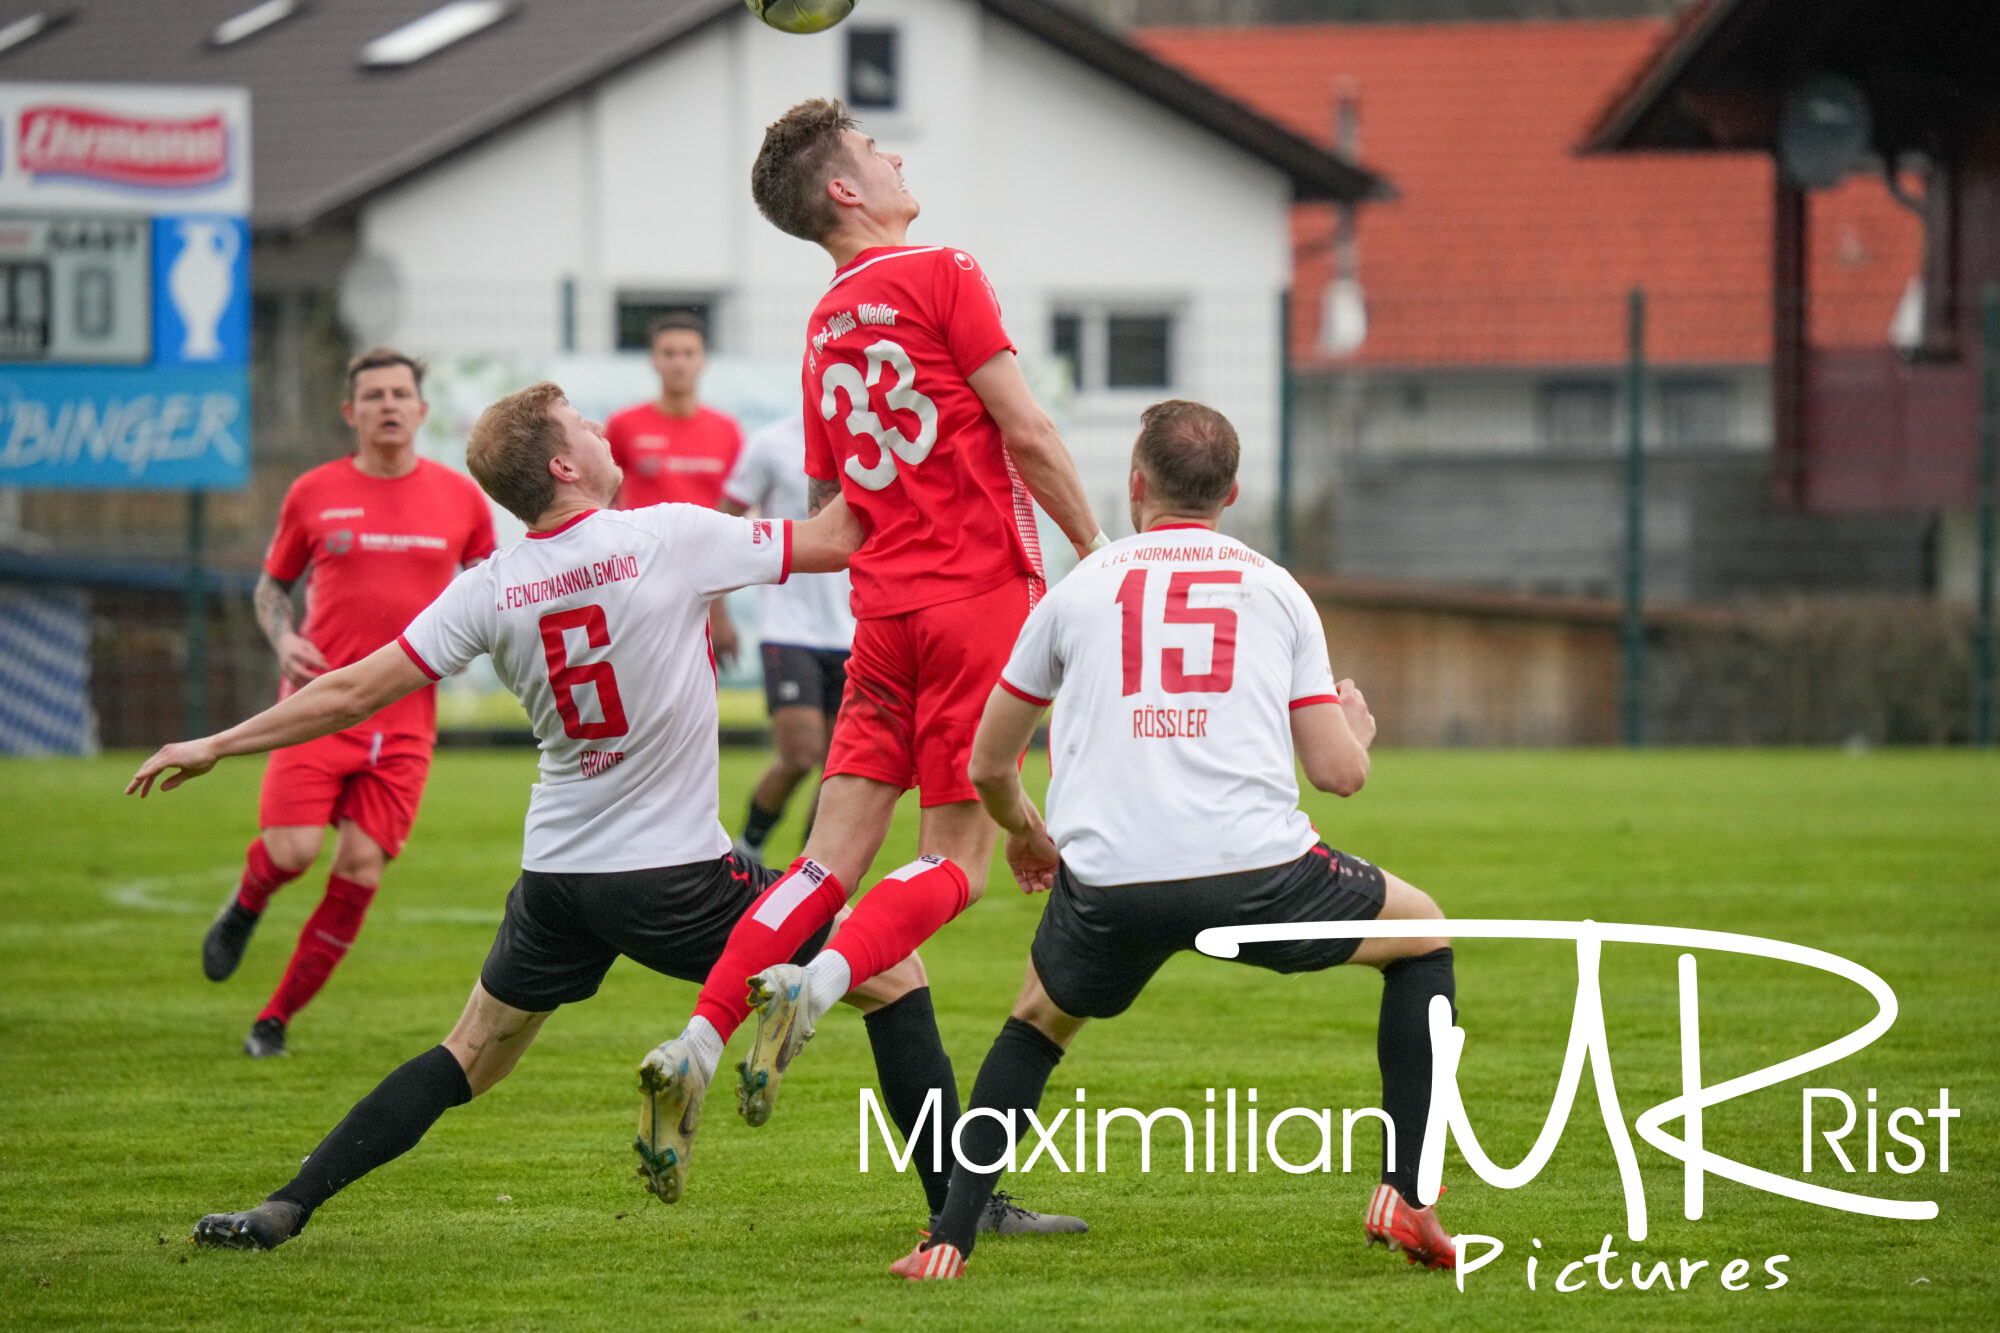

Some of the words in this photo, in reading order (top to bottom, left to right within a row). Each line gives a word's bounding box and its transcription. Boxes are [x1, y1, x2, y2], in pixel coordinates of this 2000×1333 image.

[857, 303, 900, 326] Weiler
[0, 392, 243, 476] BINGER
[821, 339, 938, 491] 33
[506, 586, 523, 610] FC
[523, 566, 594, 605] NORMANNIA
[593, 554, 639, 587] GMÜND
[1132, 546, 1214, 562] NORMANNIA
[1115, 569, 1243, 697] 15
[539, 604, 629, 740] 6
[1133, 704, 1208, 739] RÖSSLER
